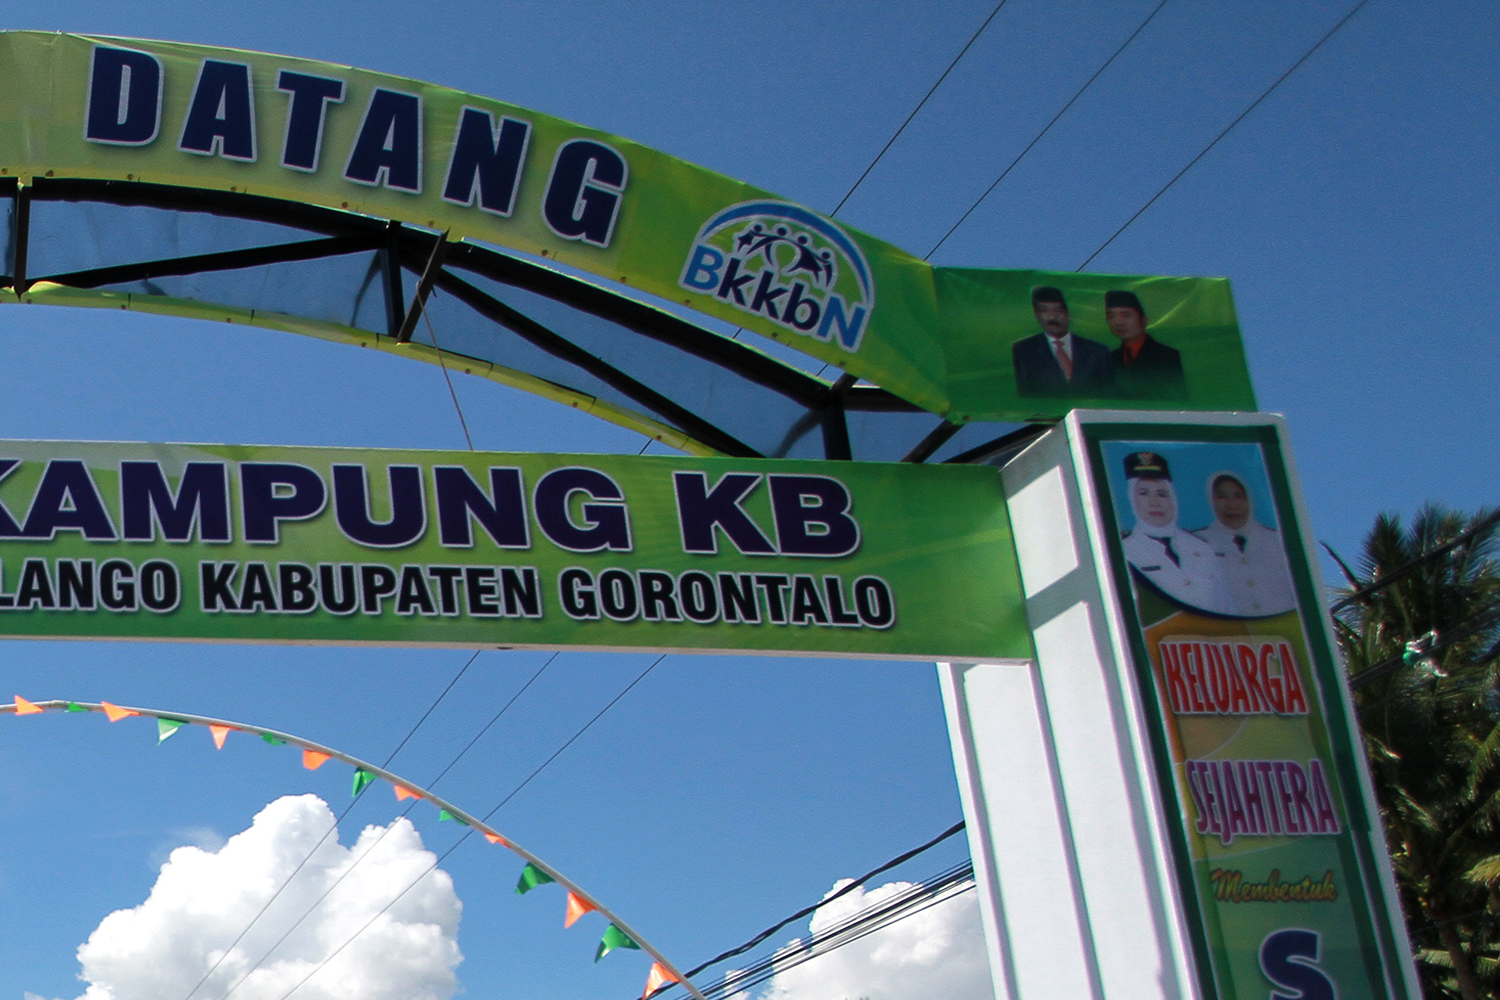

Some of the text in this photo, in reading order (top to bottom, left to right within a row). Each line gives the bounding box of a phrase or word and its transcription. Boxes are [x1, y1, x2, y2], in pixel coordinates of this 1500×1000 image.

[83, 43, 630, 248] DATANG
[672, 470, 861, 557] KB
[200, 560, 542, 618] KABUPATEN
[559, 566, 896, 629] GORONTALO
[1158, 640, 1310, 716] KELUARGA
[1185, 758, 1342, 846] SEJAHTERA
[1210, 867, 1338, 903] Membentuk
